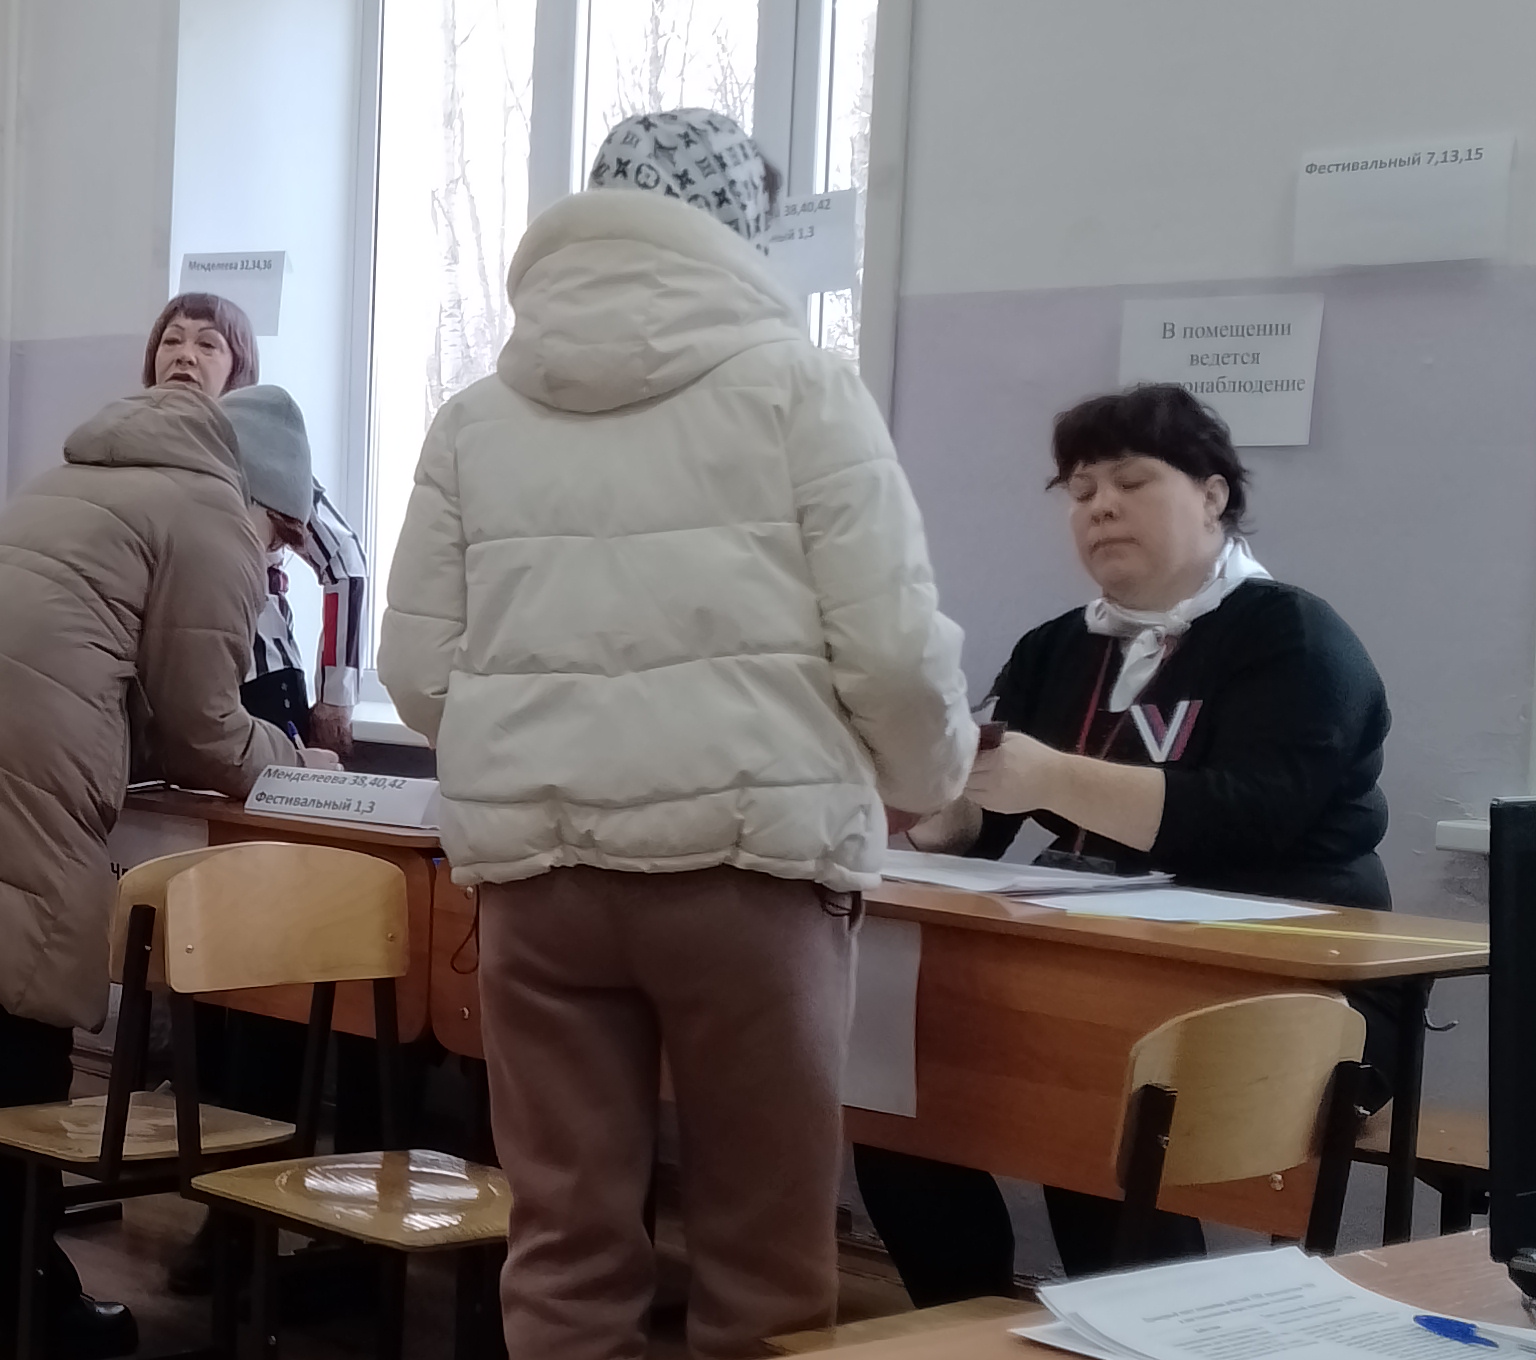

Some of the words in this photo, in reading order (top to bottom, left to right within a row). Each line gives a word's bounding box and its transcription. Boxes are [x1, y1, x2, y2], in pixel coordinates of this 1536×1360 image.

[1305, 153, 1421, 175] Фестивальный
[1426, 147, 1484, 168] 7,13,15
[1161, 322, 1176, 339] В
[1182, 322, 1292, 339] помещении
[1189, 351, 1261, 367] ведется
[1144, 375, 1307, 394] онаблюдение
[263, 768, 347, 786] Менделеева
[349, 776, 407, 790] 38,40,42
[255, 791, 352, 812] Фестивальный
[354, 799, 376, 815] 1,3
